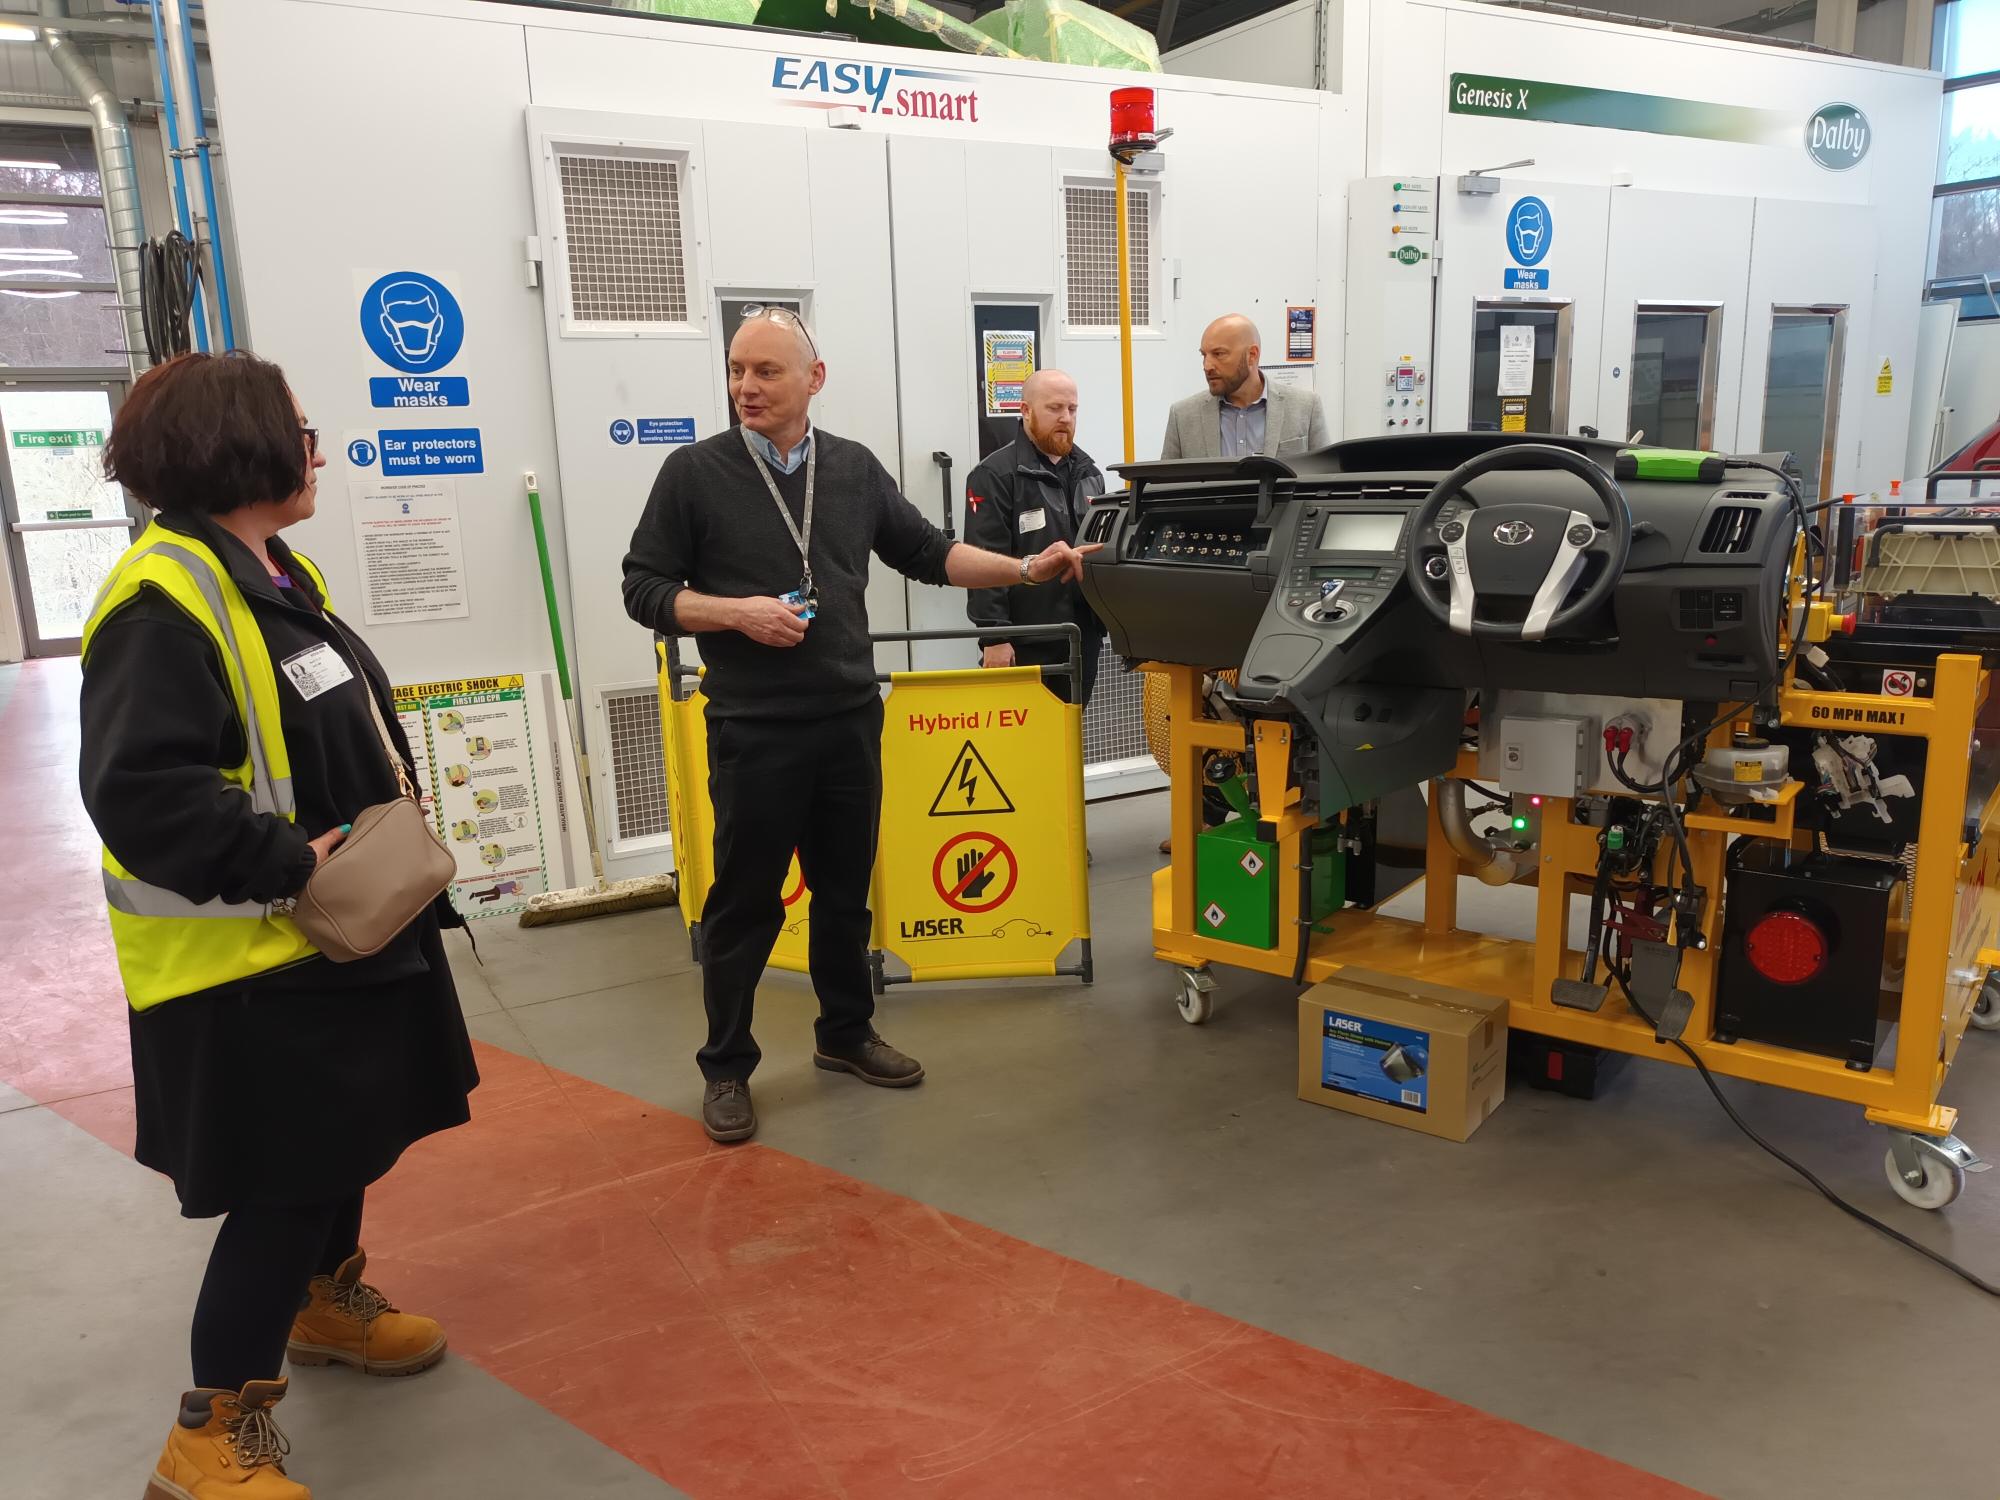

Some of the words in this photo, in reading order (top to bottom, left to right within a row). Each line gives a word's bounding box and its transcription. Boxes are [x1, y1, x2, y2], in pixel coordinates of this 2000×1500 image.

[1456, 82, 1513, 109] Genesis
[1516, 88, 1529, 111] X
[896, 88, 979, 123] smart
[1812, 115, 1865, 158] Dalby
[1399, 249, 1419, 262] Dalby
[1517, 269, 1537, 279] Wear
[1513, 280, 1539, 289] masks
[398, 378, 441, 392] Wear
[393, 393, 448, 407] masks
[20, 434, 45, 444] Fire
[48, 434, 73, 444] exit
[384, 440, 406, 451] Ear
[412, 439, 477, 452] protectors
[388, 455, 421, 466] must
[424, 454, 440, 465] be
[445, 454, 476, 464] worn
[418, 681, 463, 696] ELECTRIC
[466, 678, 499, 691] SHOCK
[453, 696, 472, 706] FIRST
[474, 695, 486, 703] AID
[486, 693, 501, 702] CPR
[909, 711, 979, 735] Hybrid
[985, 710, 992, 729] /
[999, 708, 1029, 728] EV
[1811, 706, 1830, 719] 60
[1832, 707, 1863, 722] MPH
[1866, 710, 1897, 724] MAX
[1899, 712, 1905, 725] !
[559, 803, 567, 832] INSULATED
[900, 917, 964, 938] LASER
[1328, 1016, 1362, 1033] LASER
